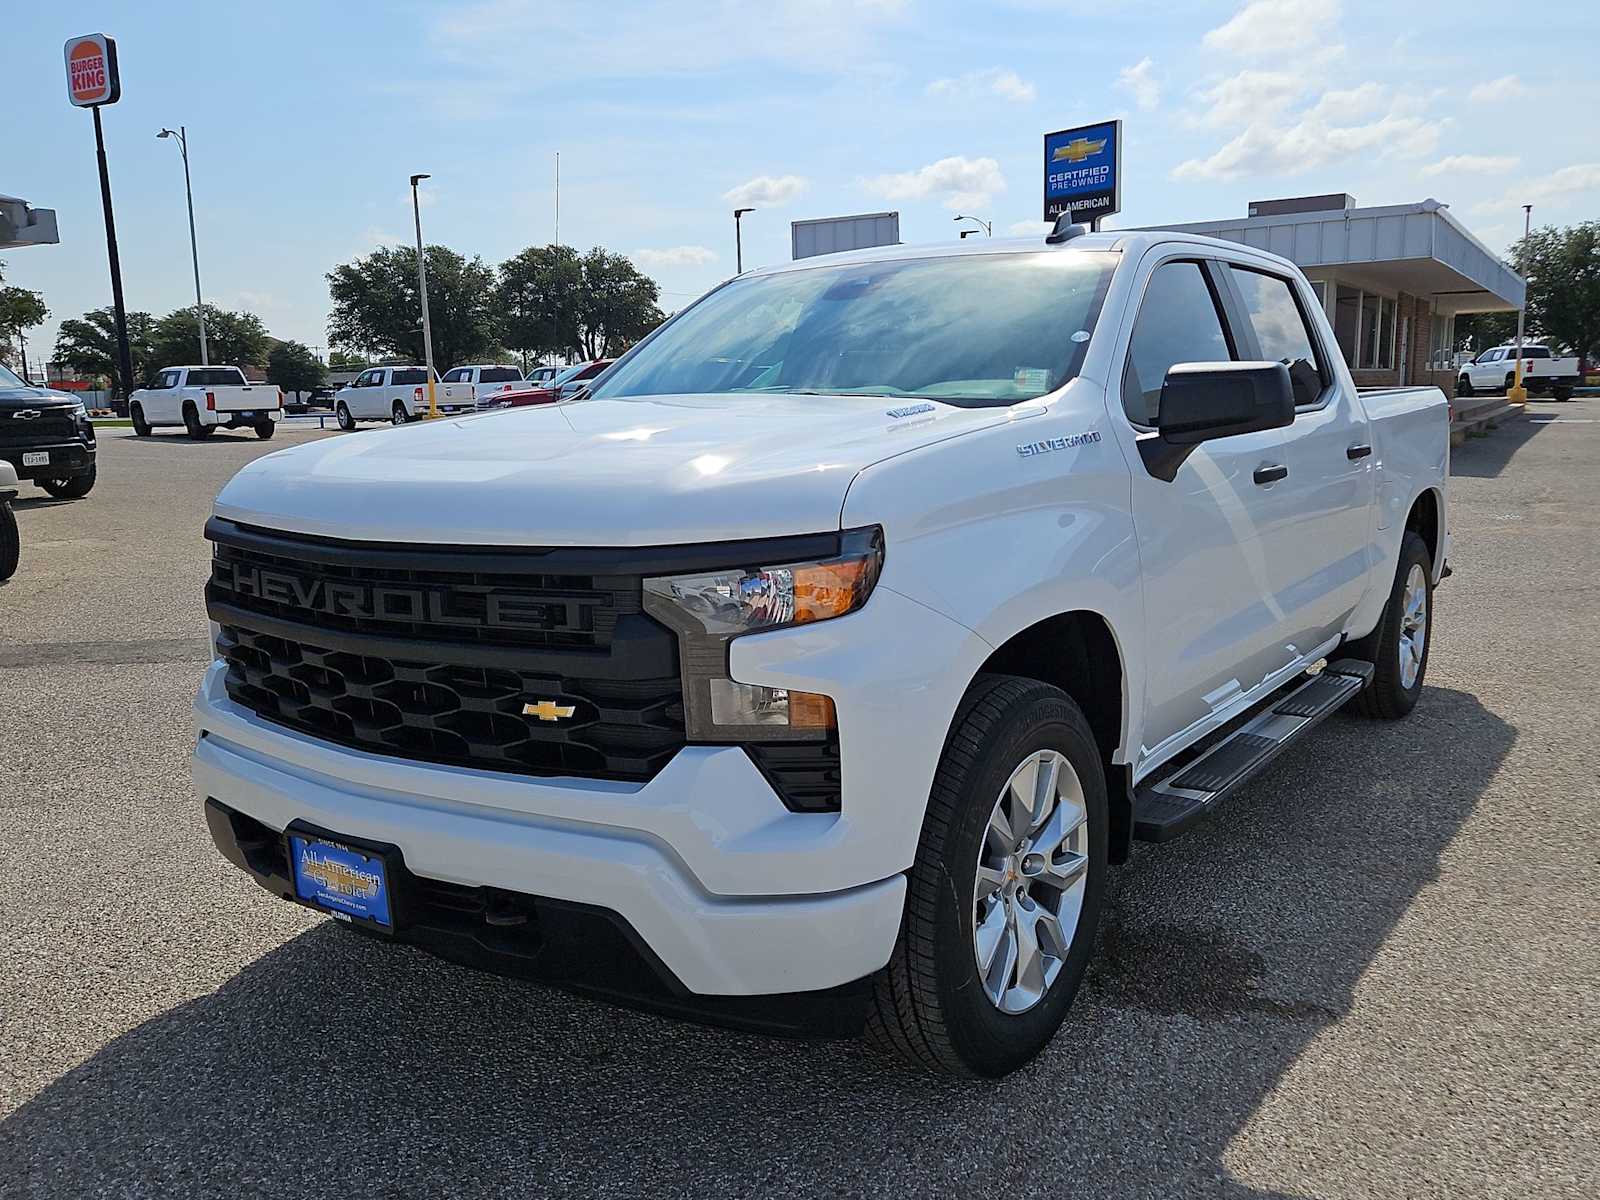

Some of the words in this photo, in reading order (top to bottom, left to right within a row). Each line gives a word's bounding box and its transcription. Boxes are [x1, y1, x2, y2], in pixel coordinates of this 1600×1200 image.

[71, 57, 104, 73] BURGER
[72, 69, 106, 91] KING
[1049, 165, 1109, 183] CERTIFIED
[1051, 175, 1106, 191] PRE-OWNED
[1049, 203, 1064, 214] ALL
[1066, 196, 1110, 212] AMERICAN
[1016, 431, 1102, 458] SILVERADO
[211, 558, 611, 632] CHEVROLET
[301, 849, 321, 867] All
[322, 855, 382, 886] American
